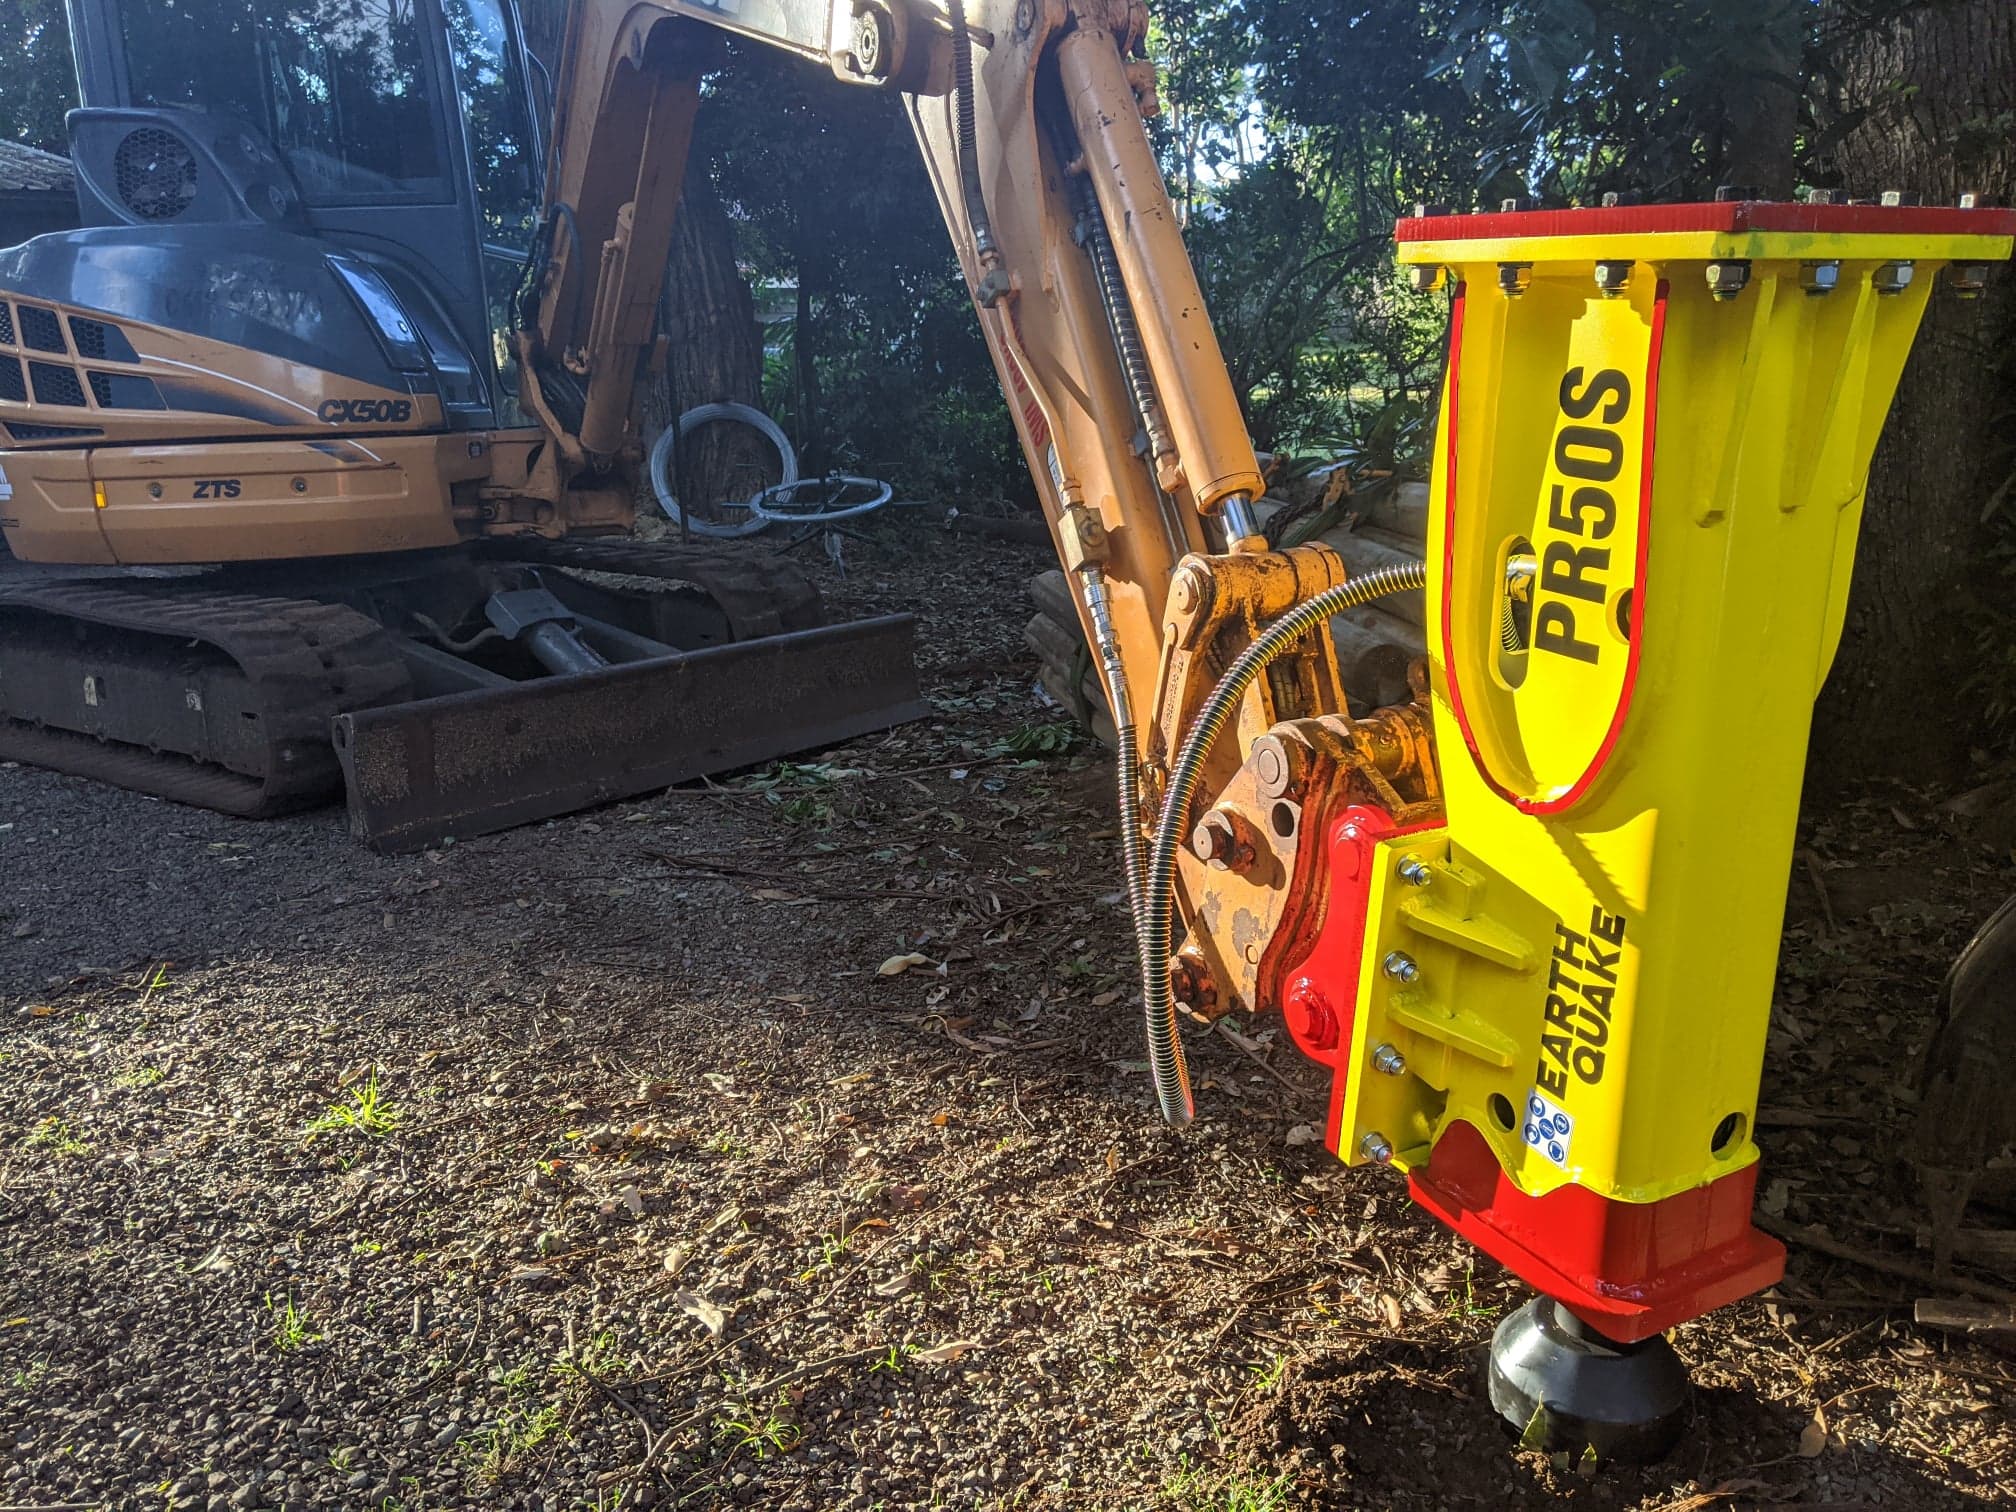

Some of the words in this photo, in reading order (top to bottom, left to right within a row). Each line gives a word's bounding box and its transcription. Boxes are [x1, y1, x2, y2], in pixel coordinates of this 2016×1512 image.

[193, 479, 242, 499] ZTS
[318, 399, 412, 423] CX50B
[1534, 366, 1631, 665] PR50S
[1536, 922, 1588, 1101] EARTH
[1572, 904, 1627, 1086] QUAKE
